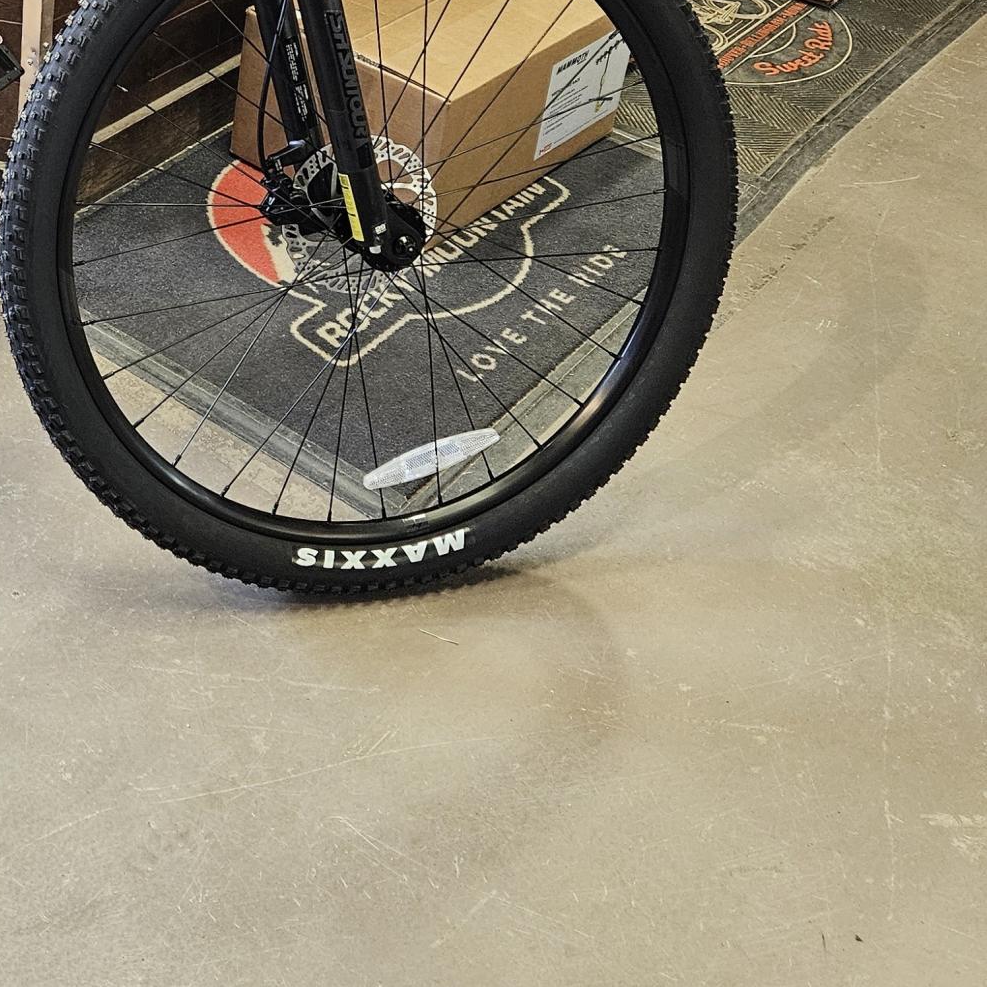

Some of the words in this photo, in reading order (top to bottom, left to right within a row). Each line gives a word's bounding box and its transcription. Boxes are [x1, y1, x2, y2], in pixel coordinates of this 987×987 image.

[753, 50, 826, 77] Sweet
[317, 269, 418, 349] ROCKY
[457, 326, 529, 384] LOVE
[521, 287, 575, 327] THE
[570, 243, 628, 288] RIDE
[295, 527, 469, 570] MAXXIS
